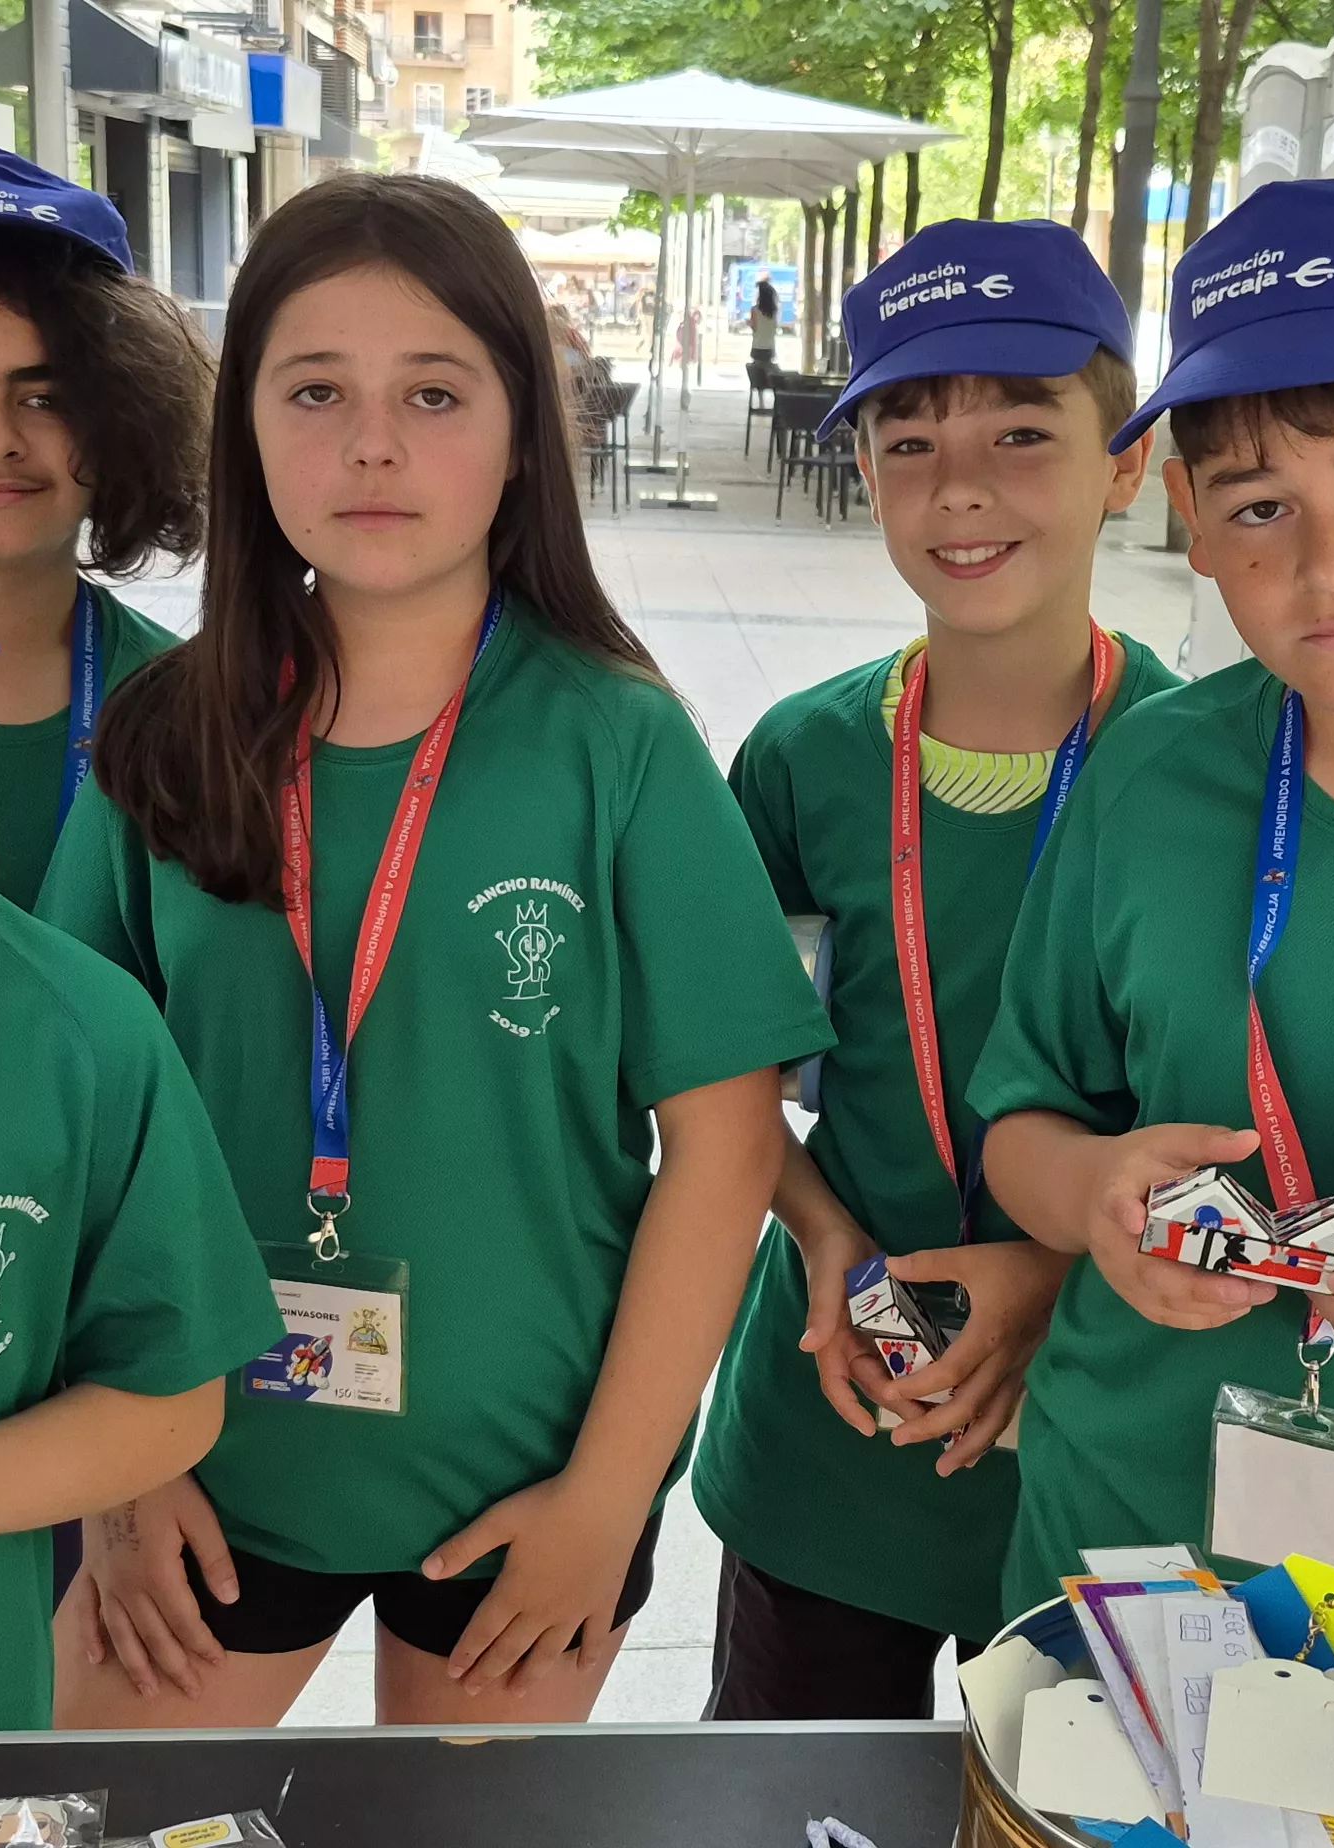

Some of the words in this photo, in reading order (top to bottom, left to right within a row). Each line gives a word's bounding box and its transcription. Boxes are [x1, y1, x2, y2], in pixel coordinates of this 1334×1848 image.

[879, 261, 966, 302] Fundación
[1191, 249, 1284, 294] Fundación
[1191, 269, 1278, 319] Ibercaja
[878, 279, 967, 321] Ibercaja
[85, 600, 94, 653] EMPRENDER
[86, 654, 93, 662] A
[82, 663, 94, 730] APRENDIENDO
[902, 676, 919, 745] EMPRENDER
[421, 718, 447, 770] IBERCAJA
[903, 743, 910, 752] A
[1281, 696, 1293, 768] EMPRENDER
[902, 754, 910, 836] APRENDIENDO
[1281, 767, 1291, 776] A
[388, 795, 421, 879] APRENDIENDO
[1273, 778, 1289, 860] APRENDIENDO
[383, 880, 394, 891] A
[467, 878, 527, 913] SANCHO
[530, 878, 586, 913] RAMÍREZ
[904, 867, 914, 925] IBERCAJA
[367, 892, 392, 965] EMPRENDER
[1257, 892, 1280, 954] IBERCAJA
[359, 967, 372, 995] CON
[904, 928, 923, 998] FUNDACIÓN
[489, 1010, 530, 1037] 2019
[915, 1000, 925, 1024] CON
[919, 1025, 936, 1097] EMPRENDER
[1259, 1083, 1274, 1114] CON
[1267, 1116, 1299, 1198] FUNDACIÓN
[1222, 1606, 1246, 1636] LEER
